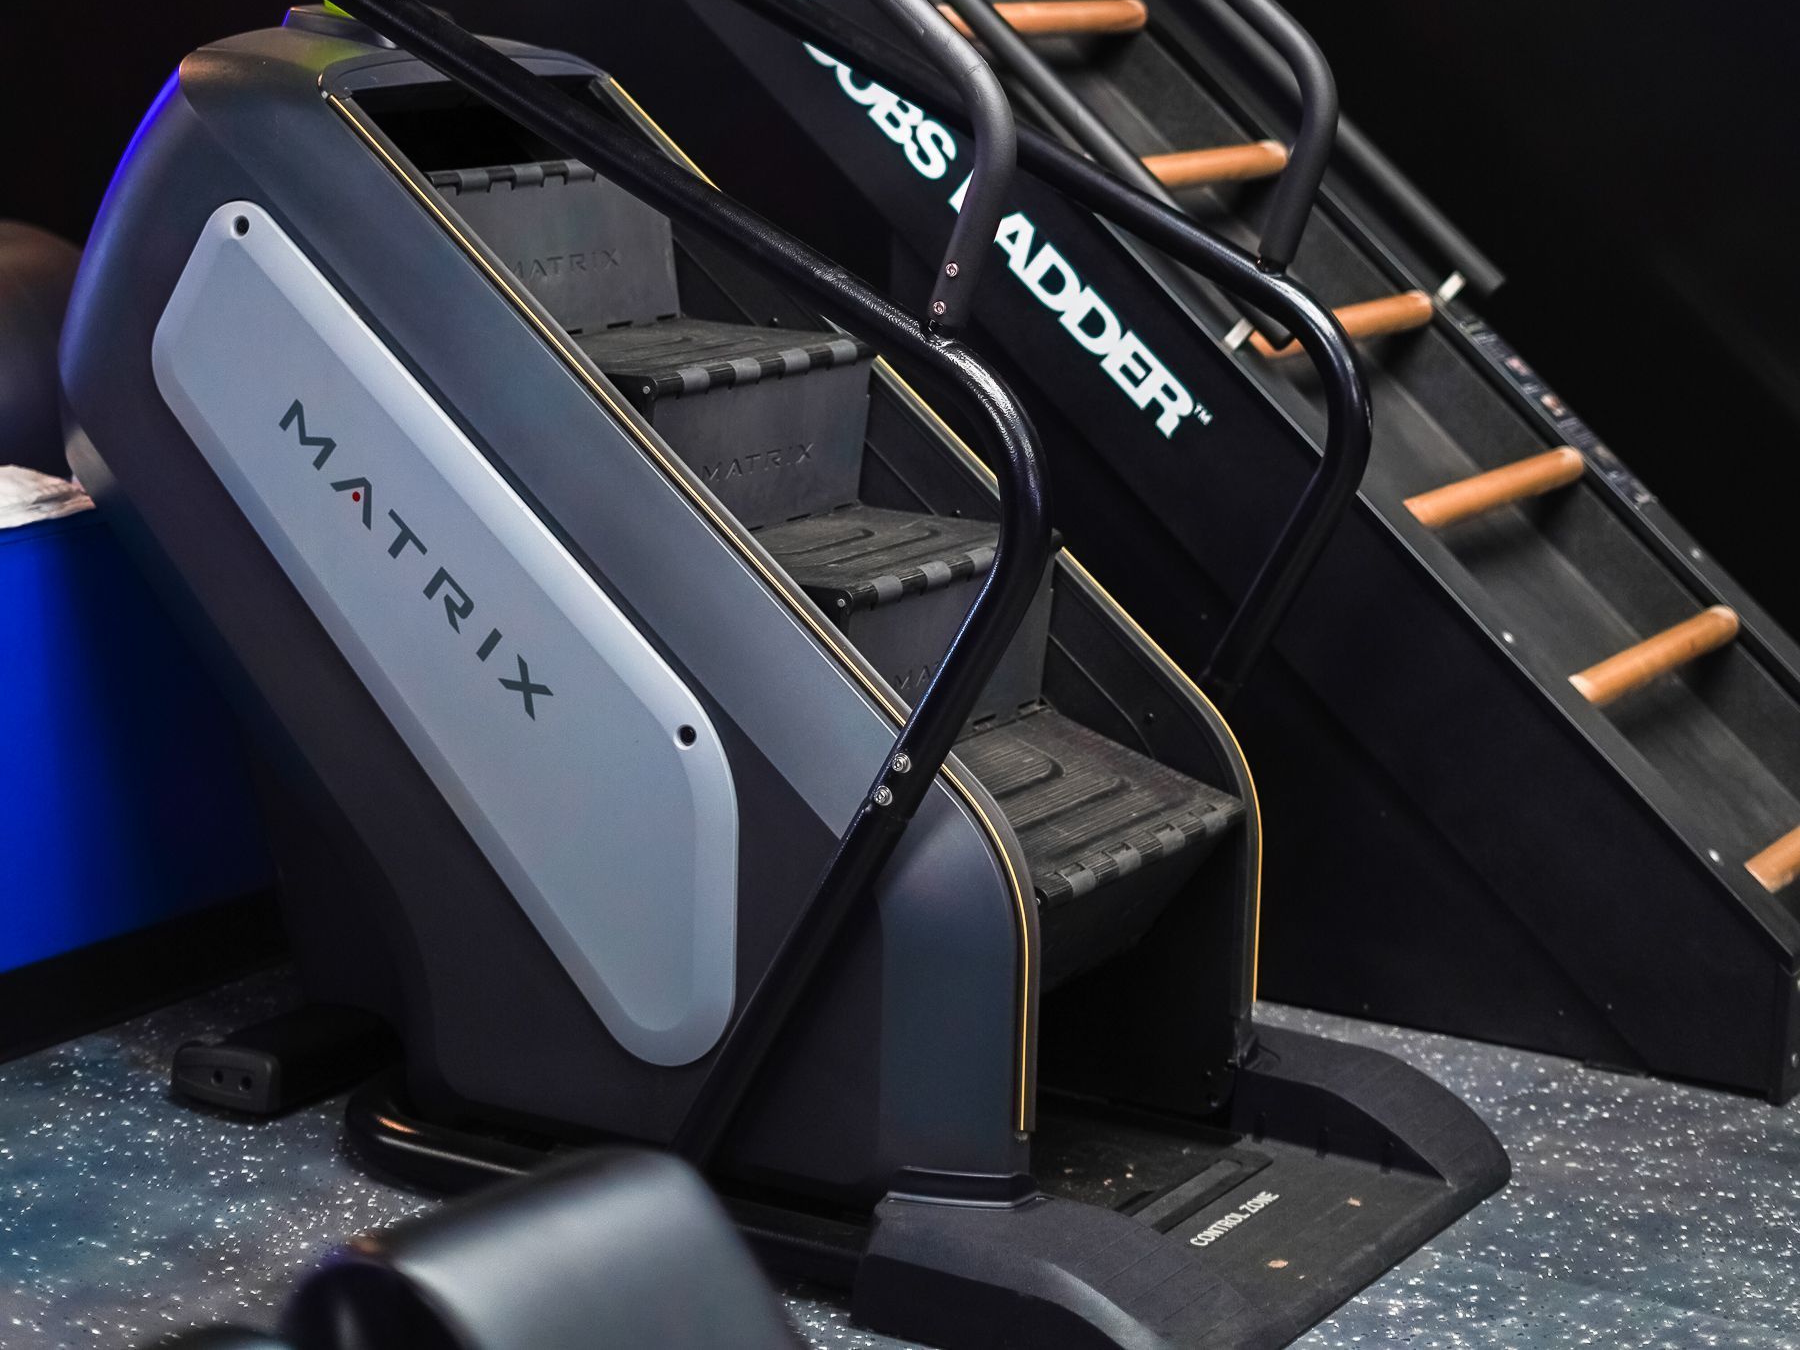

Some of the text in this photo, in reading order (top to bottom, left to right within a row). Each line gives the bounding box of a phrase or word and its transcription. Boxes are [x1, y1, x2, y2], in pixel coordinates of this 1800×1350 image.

[949, 168, 1195, 438] ADDER
[279, 399, 554, 722] MATRIX
[1190, 1191, 1280, 1246] CONTROL ZONE
